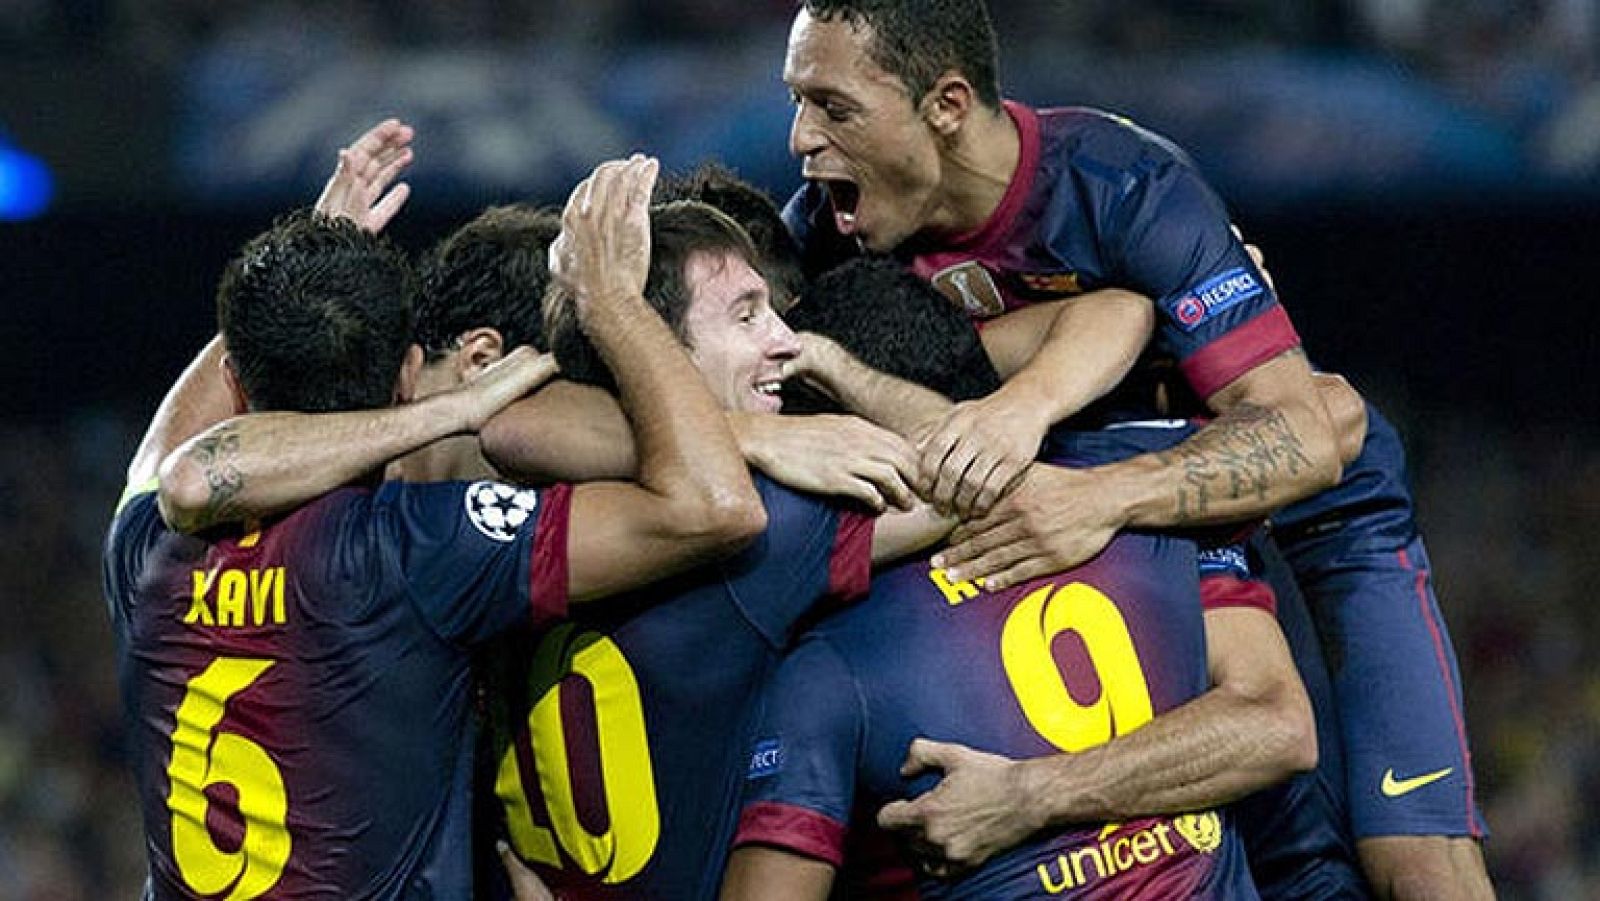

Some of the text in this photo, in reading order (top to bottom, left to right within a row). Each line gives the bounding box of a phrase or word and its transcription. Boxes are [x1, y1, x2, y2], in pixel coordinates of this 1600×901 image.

[182, 565, 287, 627] XAVI
[1001, 582, 1153, 754] 9
[168, 657, 292, 901] 6
